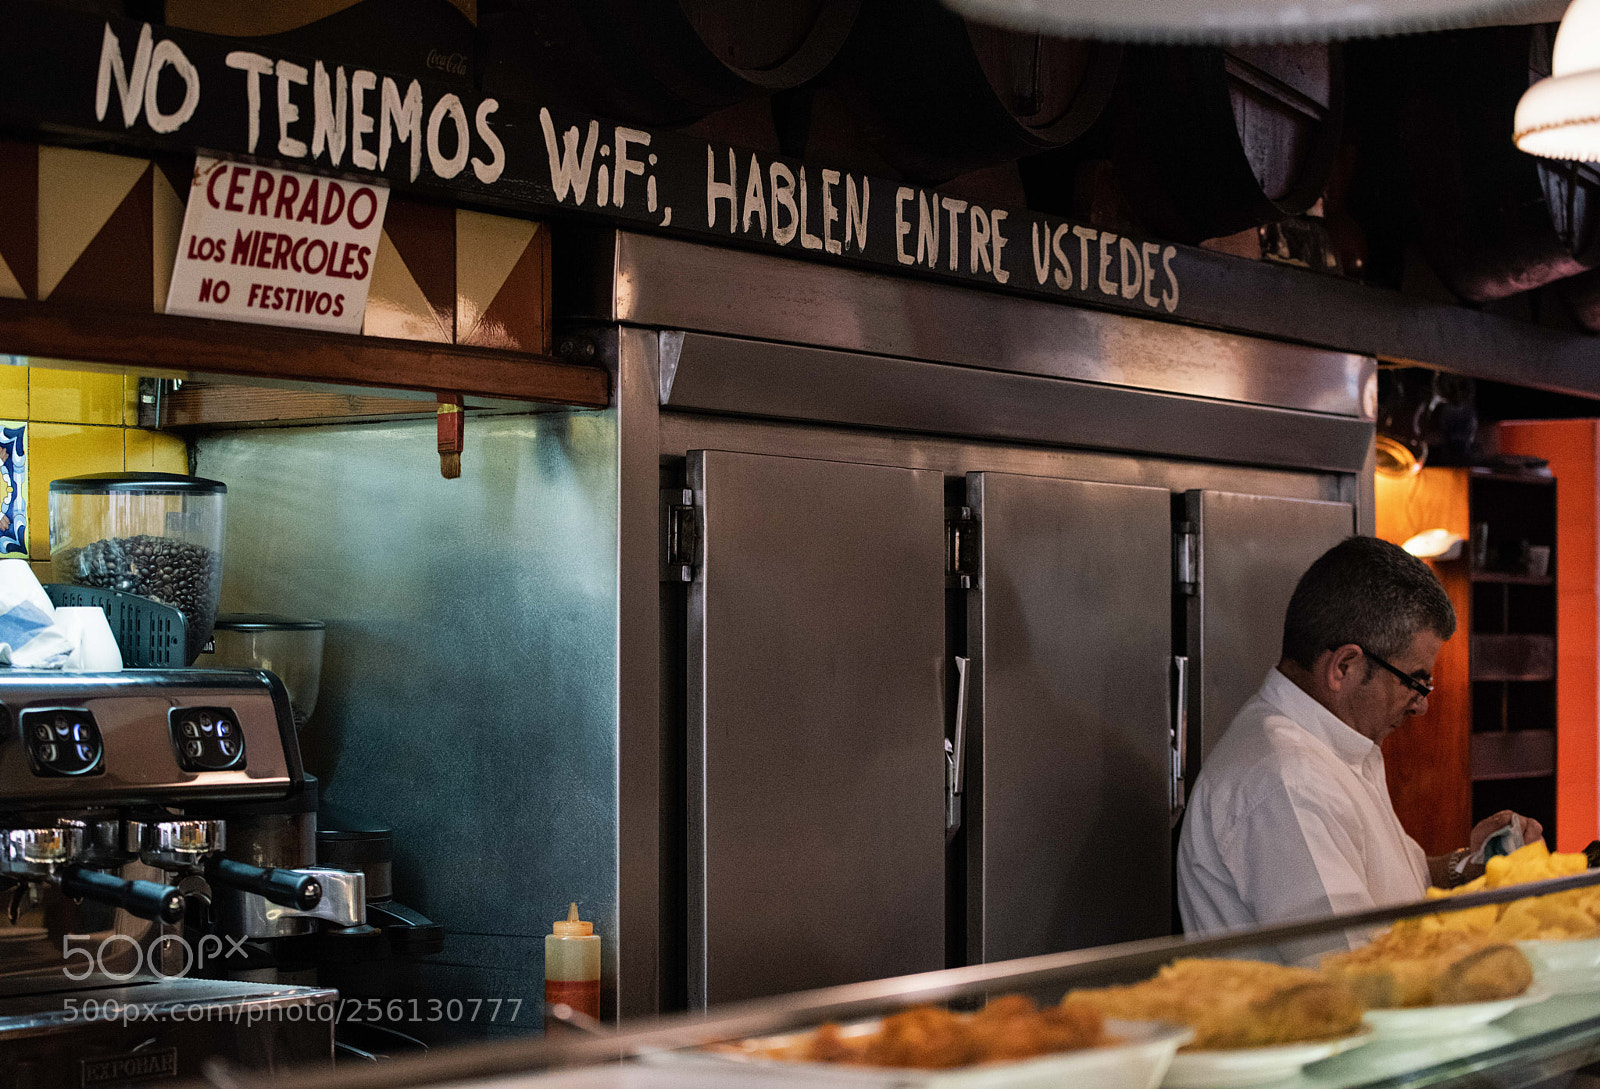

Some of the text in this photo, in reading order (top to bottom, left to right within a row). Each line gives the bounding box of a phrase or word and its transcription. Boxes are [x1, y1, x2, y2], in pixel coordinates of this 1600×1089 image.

[95, 22, 1179, 313] NO TENEMOS WiFi, HABLEN ENTRE USTEDES
[206, 166, 378, 230] CERRADO
[187, 228, 372, 281] LOS MIERCOLES
[198, 278, 346, 318] NO FESTIVOS
